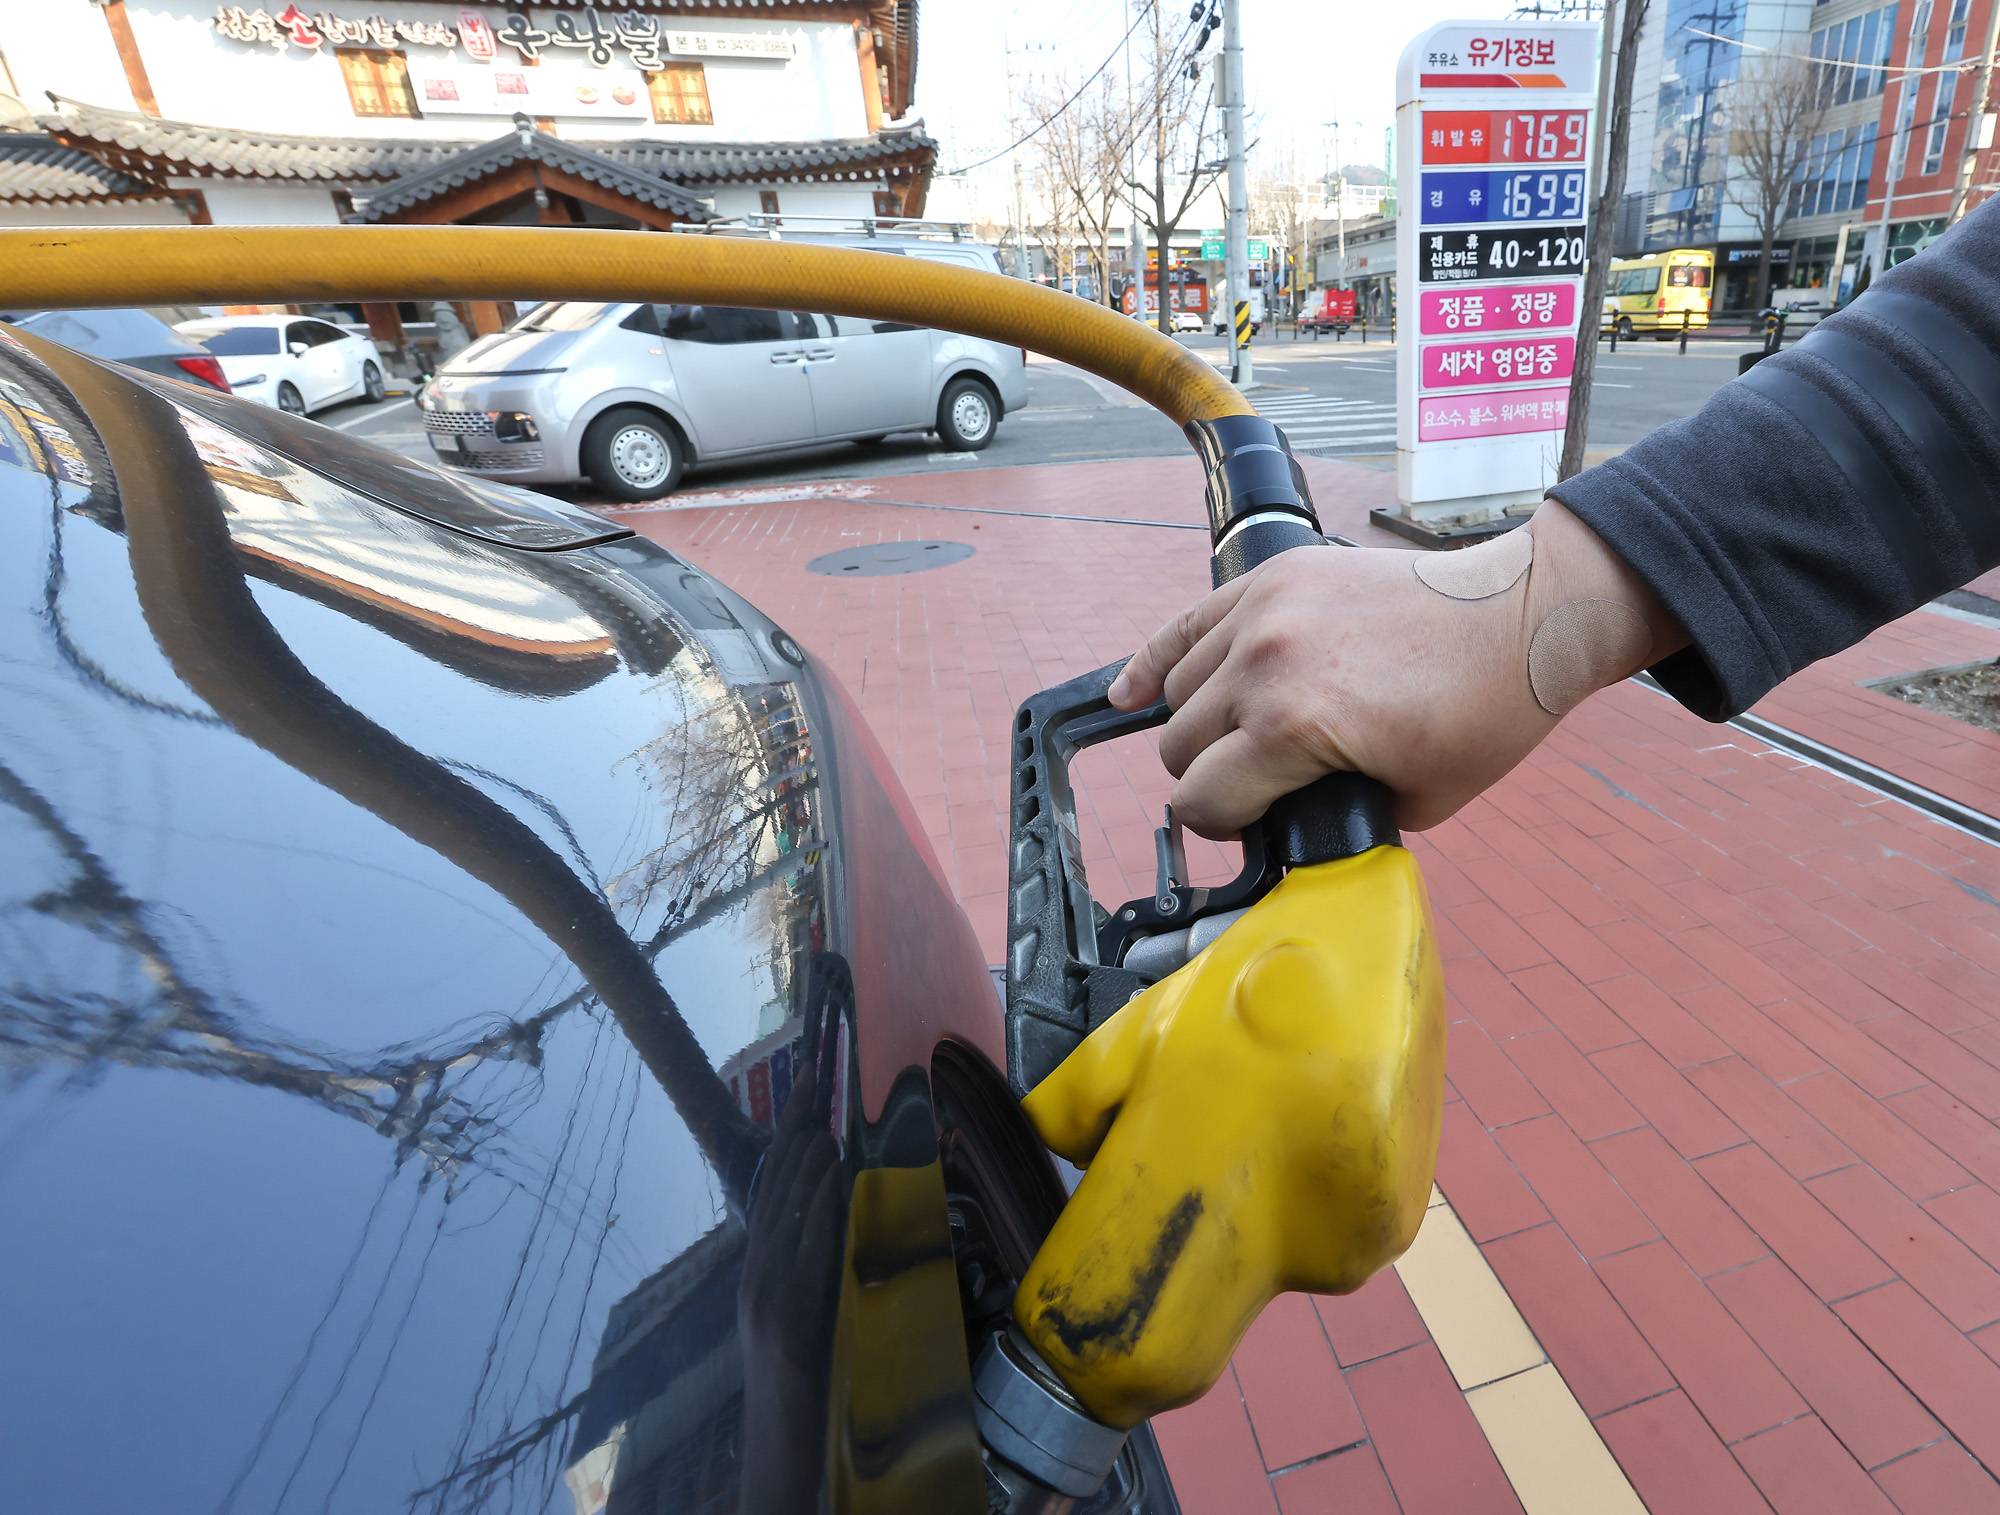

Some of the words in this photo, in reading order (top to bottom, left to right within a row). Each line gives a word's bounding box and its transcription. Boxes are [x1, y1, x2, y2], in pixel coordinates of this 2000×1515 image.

[1428, 52, 1459, 67] 주유소
[1468, 38, 1556, 67] 유가정보
[1431, 129, 1484, 148] 휘발유
[1503, 114, 1586, 159] 1769
[1503, 173, 1584, 218] 1699
[1430, 251, 1479, 268] 신용카드
[1489, 237, 1584, 269] 40~120
[1438, 296, 1486, 328] 정품
[1510, 291, 1557, 324] 정량
[1438, 350, 1485, 377] 세차
[1491, 344, 1558, 378] 영업중
[1423, 409, 1466, 428] 요소수,
[1501, 403, 1538, 422] 워셔액
